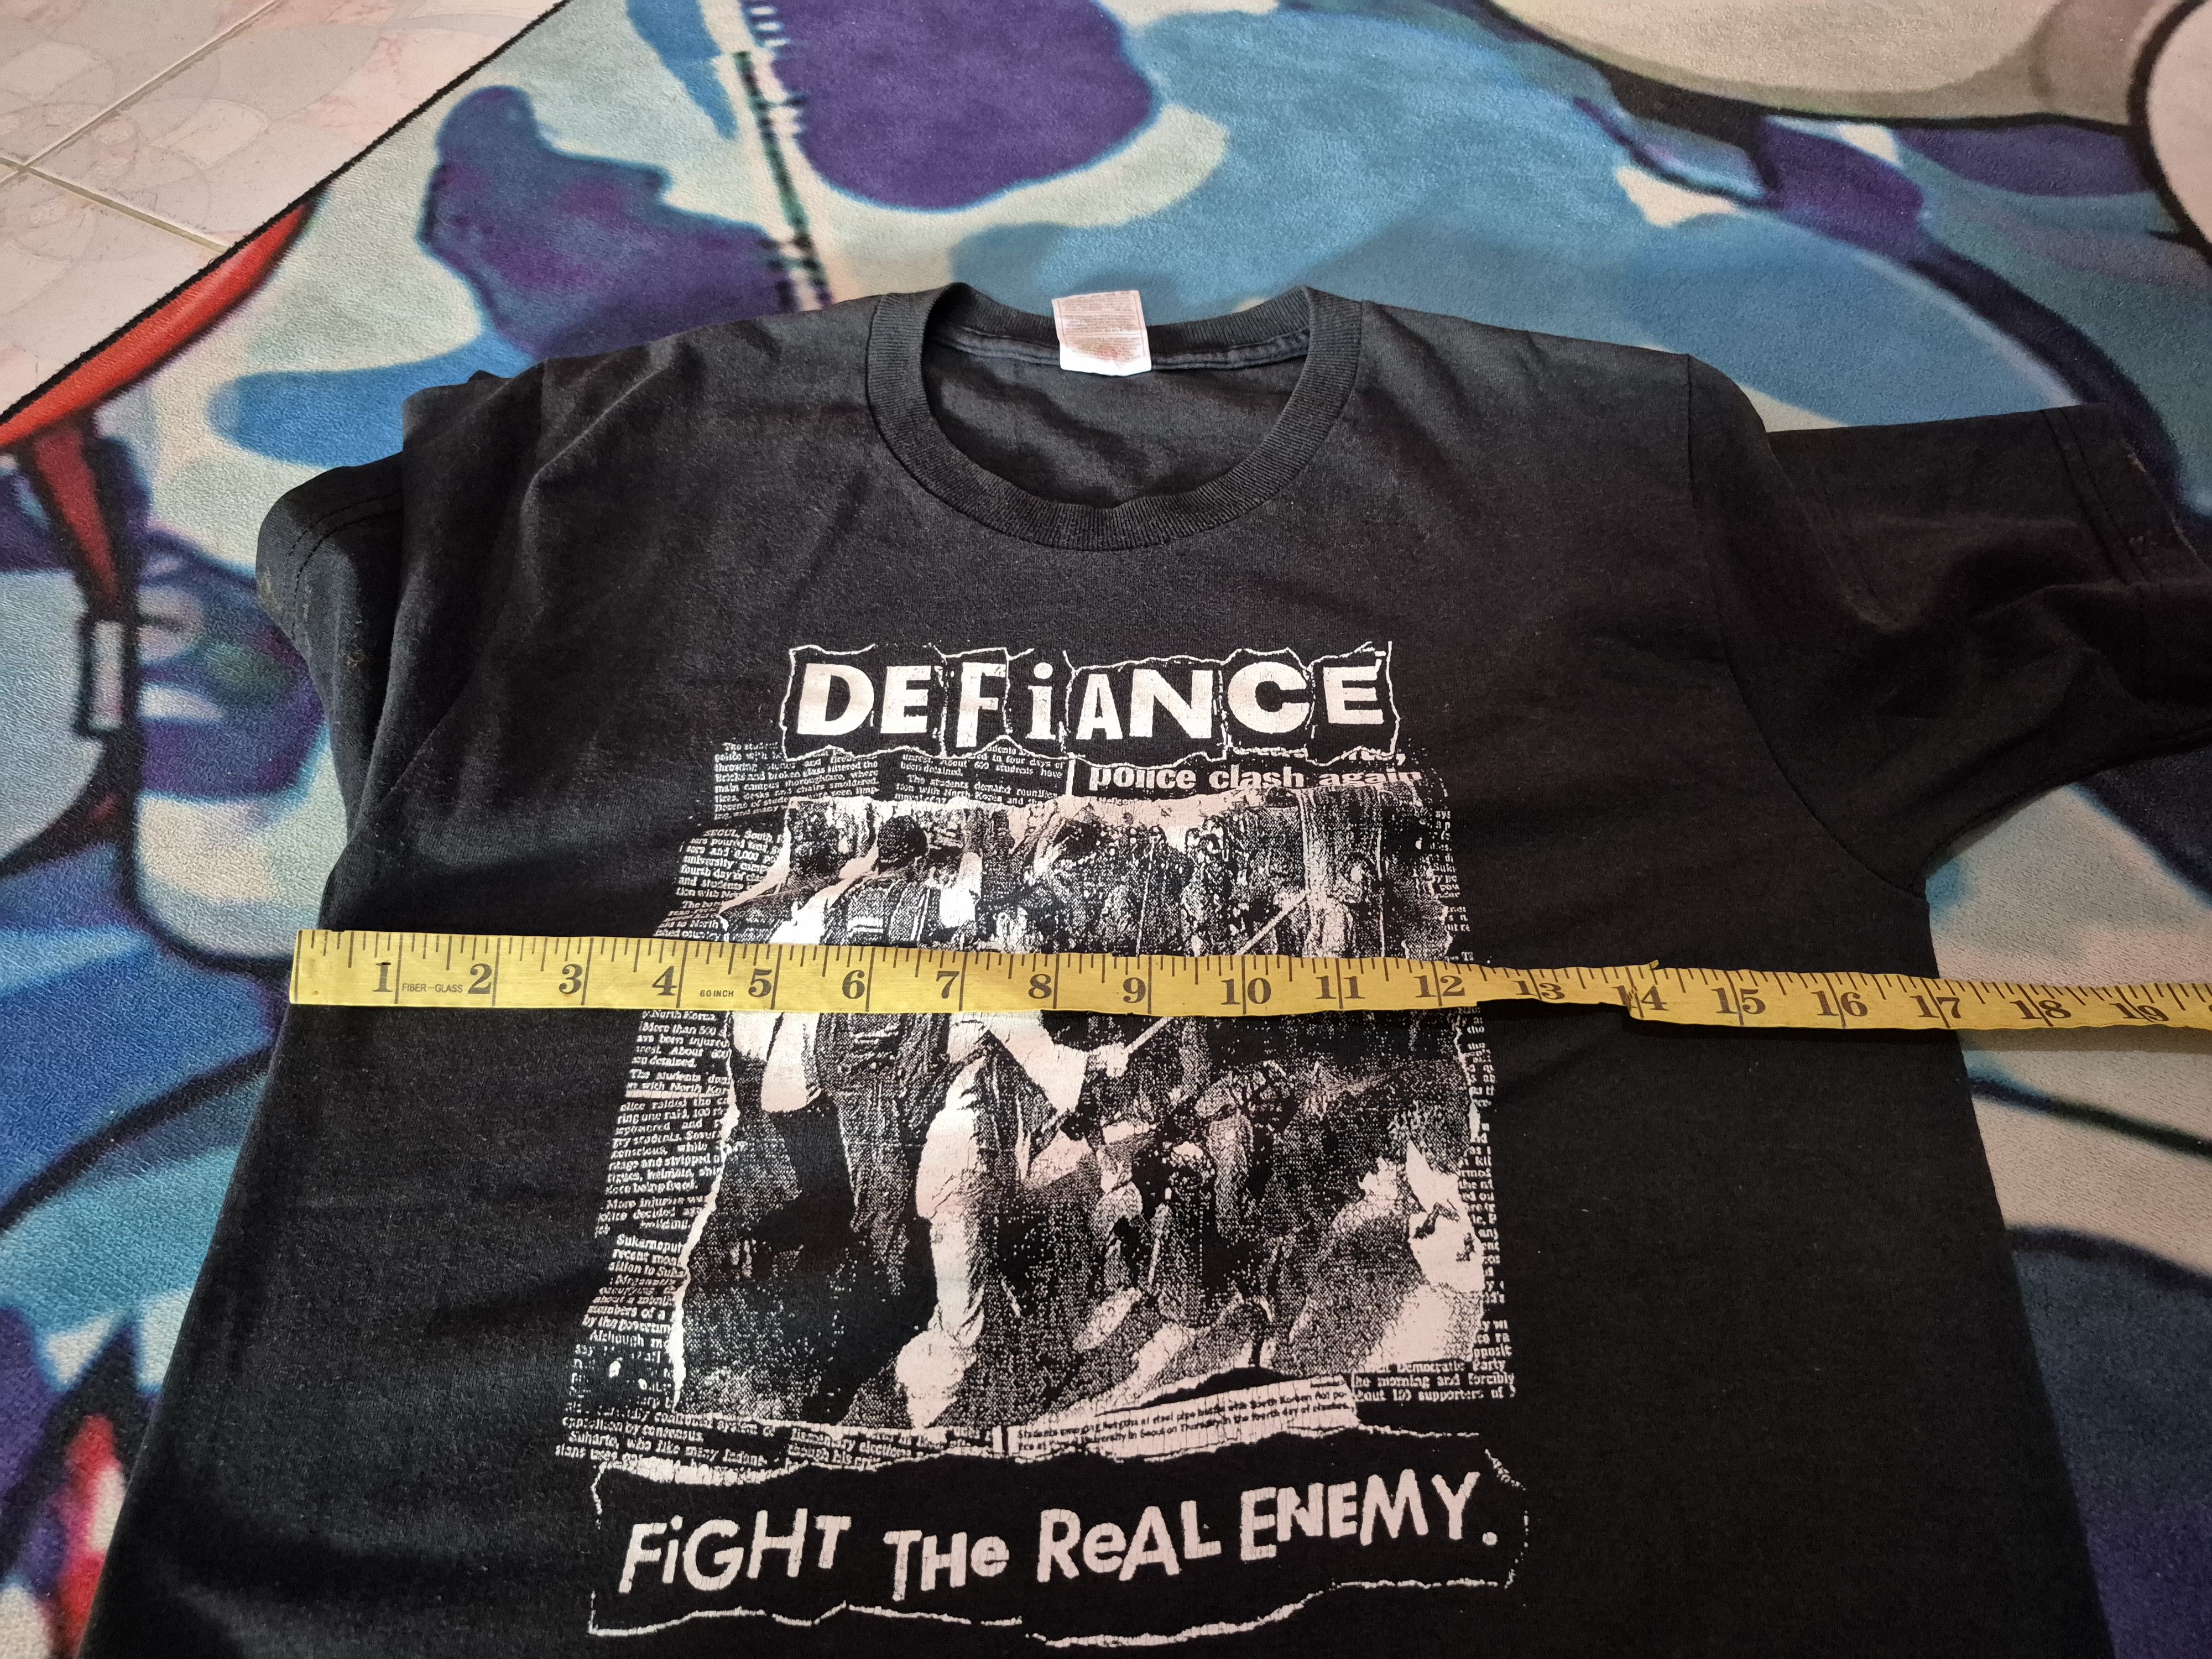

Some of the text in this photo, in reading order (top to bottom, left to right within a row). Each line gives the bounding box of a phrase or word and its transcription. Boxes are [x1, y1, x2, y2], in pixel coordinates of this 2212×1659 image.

[1209, 764, 1305, 790] clash
[373, 962, 393, 993] 1
[467, 963, 494, 994] 2
[559, 963, 583, 994] 3
[652, 966, 677, 996] 4
[713, 989, 734, 998] INCH
[748, 968, 773, 998] 5
[842, 970, 865, 999] 6
[936, 971, 961, 999] 7
[1028, 973, 1052, 1000] 8
[1123, 977, 1147, 1004] 9
[1220, 977, 1272, 1005] 10
[1315, 975, 1365, 1000] 11
[1413, 974, 1466, 999] 12
[1512, 980, 1566, 1001] 13
[1710, 987, 1767, 1015] 15
[1811, 990, 1868, 1017] 16
[1910, 994, 1963, 1019] 17
[2010, 999, 2072, 1020] 18
[2108, 1002, 2170, 1022] 19
[1240, 1469, 1498, 1561] ENEMY.
